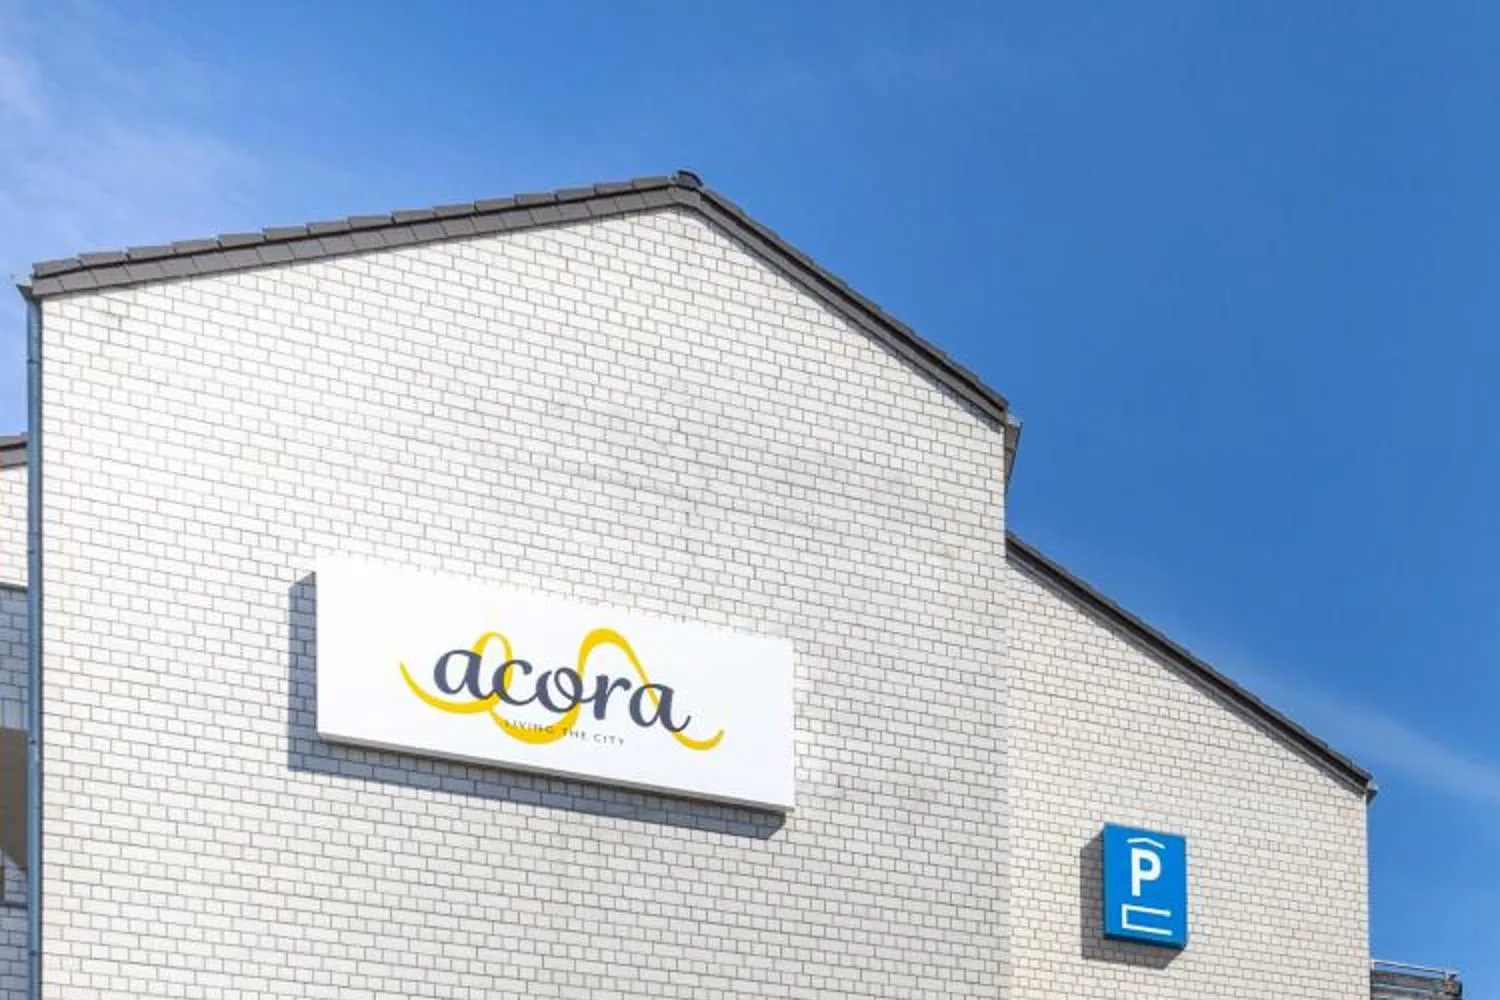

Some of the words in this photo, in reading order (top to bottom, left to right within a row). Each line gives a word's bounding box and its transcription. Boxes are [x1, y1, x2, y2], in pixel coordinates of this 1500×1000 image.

[433, 648, 692, 733] acora
[504, 719, 554, 735] LIVING
[562, 726, 586, 741] THE
[593, 733, 625, 746] CITY
[1131, 847, 1161, 897] P
